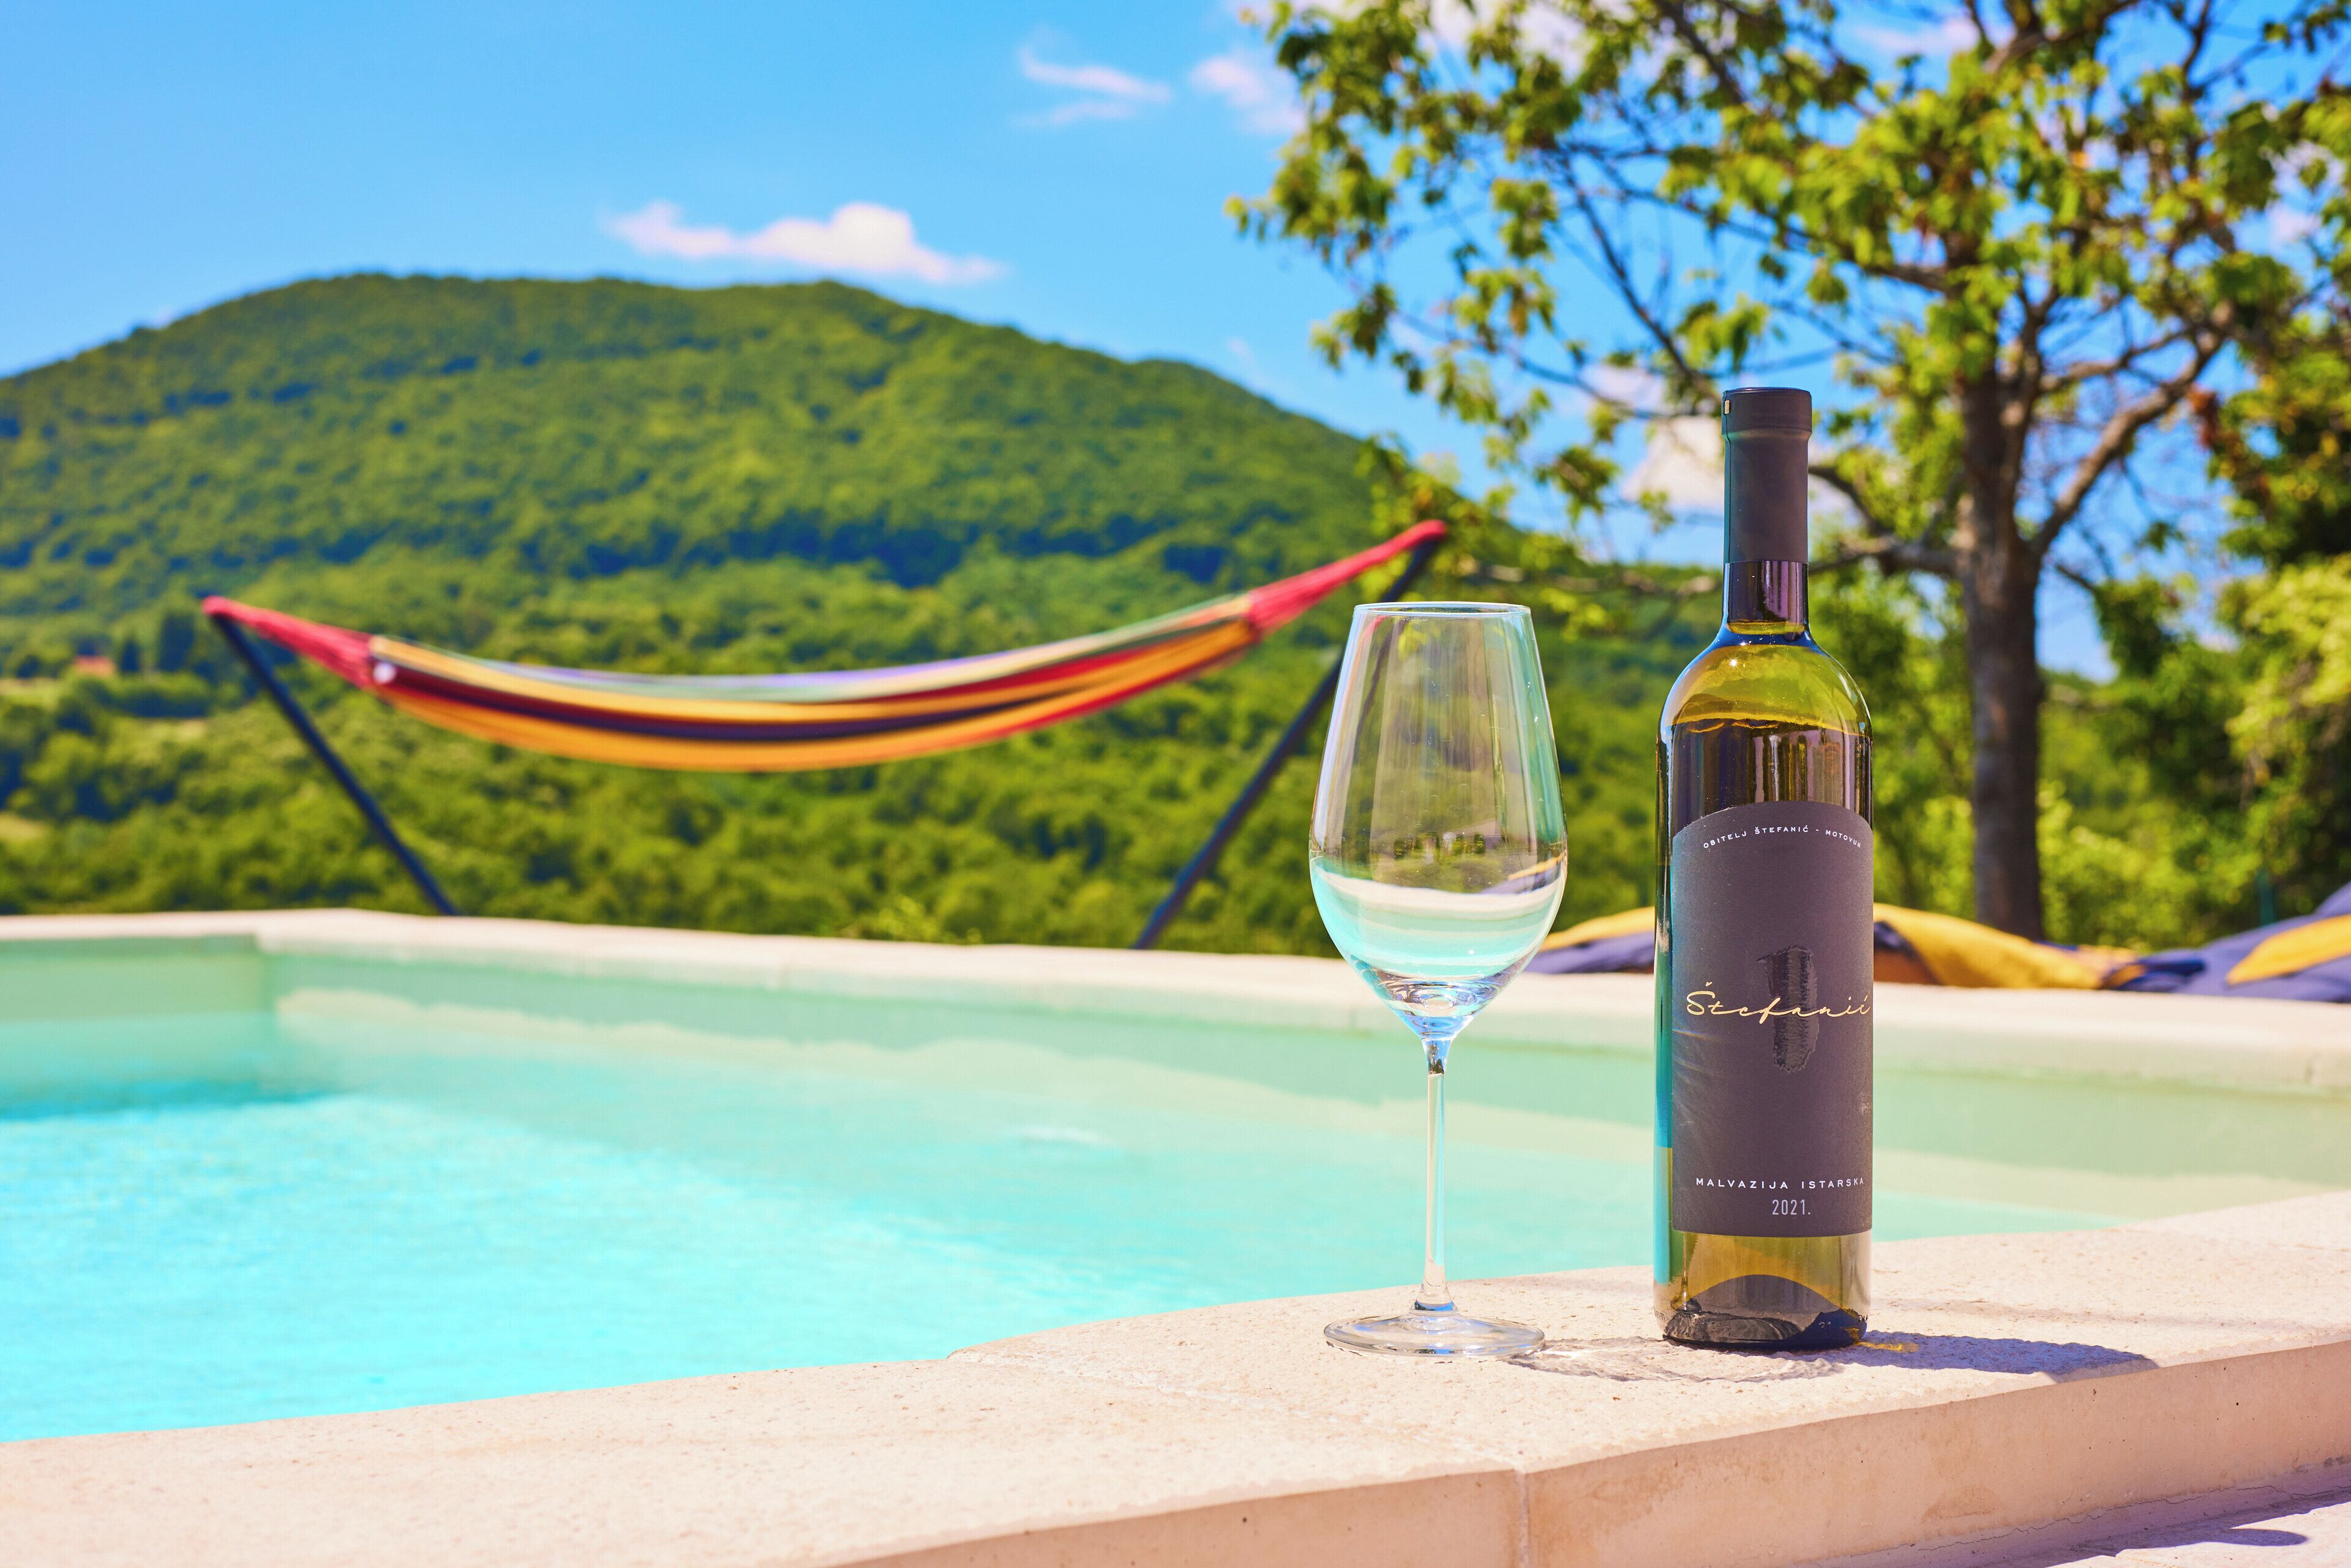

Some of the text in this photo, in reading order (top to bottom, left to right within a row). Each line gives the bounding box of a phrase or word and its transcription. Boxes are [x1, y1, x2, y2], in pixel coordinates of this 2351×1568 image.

[1703, 830, 1747, 849] OBITELJ
[1754, 825, 1809, 835] ŠTEFANIĆ
[1825, 829, 1861, 849] MOTOVUN
[1686, 981, 1870, 1024] Štefanić
[1695, 1177, 1864, 1189] MALVAZIJA ISTARSKA
[1772, 1199, 1811, 1215] 2021.
